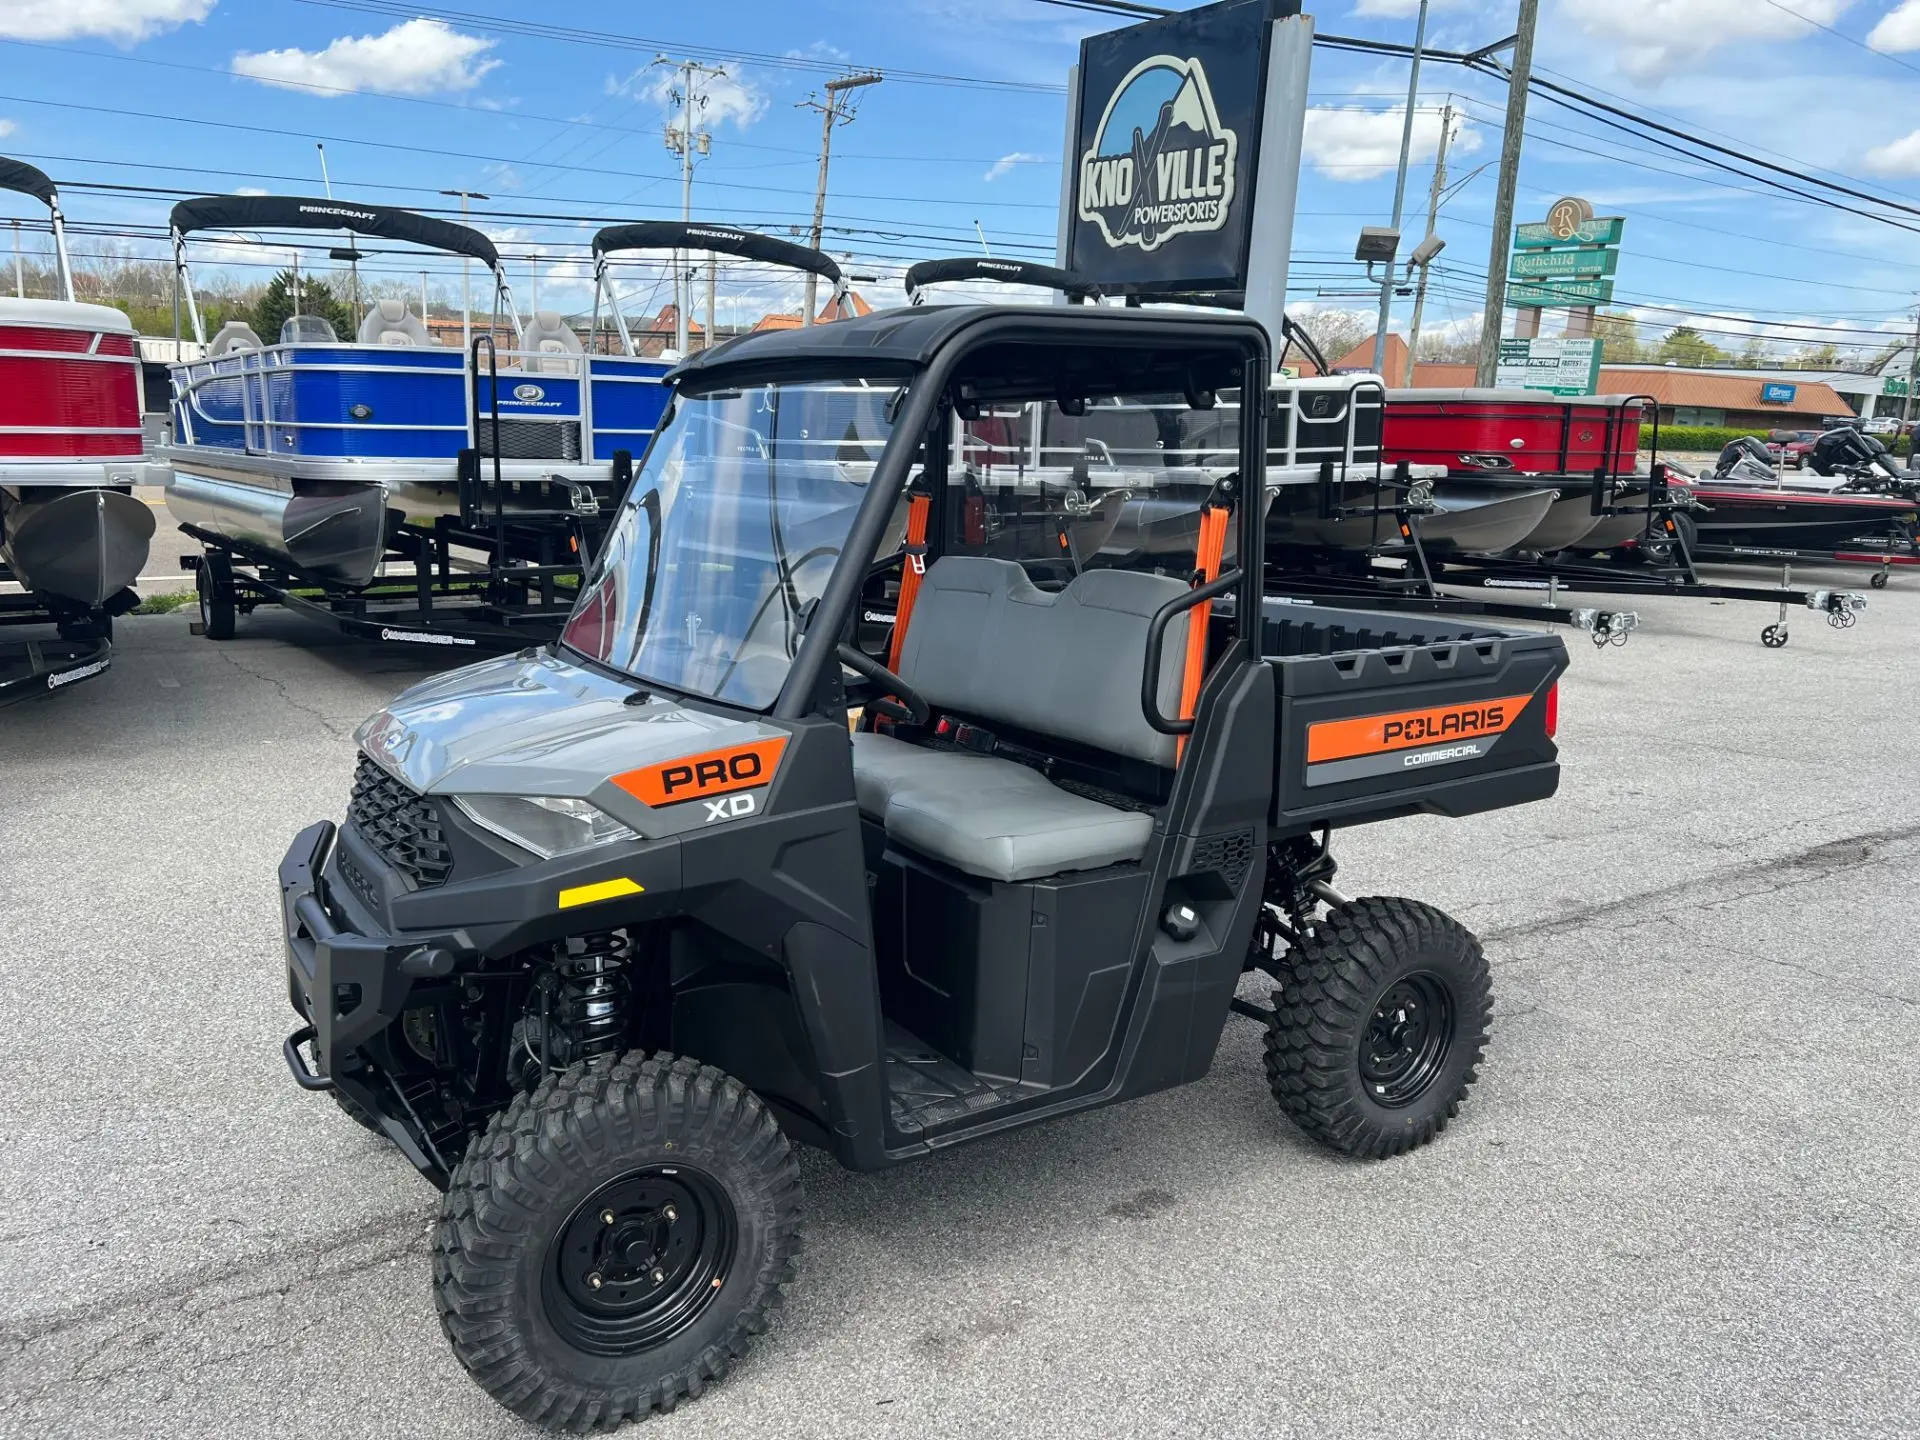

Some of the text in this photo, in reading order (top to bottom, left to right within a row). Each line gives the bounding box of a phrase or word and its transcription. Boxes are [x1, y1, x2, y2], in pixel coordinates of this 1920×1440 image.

[1083, 144, 1226, 209] KNOXVILLE
[299, 205, 376, 220] PRINCECRAFT
[1134, 200, 1219, 225] POWERSPORTS
[686, 228, 745, 241] PRINCECRAFT
[977, 261, 1022, 272] PRINCECRAFT
[1515, 253, 1576, 275] Rothchild
[1577, 265, 1603, 273] CENTER
[496, 400, 563, 408] PRINCECRAFT
[1734, 548, 1771, 556] Ranger
[1383, 706, 1505, 744] POLARIS
[1404, 744, 1481, 766] COMMERCIAL
[661, 752, 761, 794] PRO
[703, 793, 755, 823] XD
